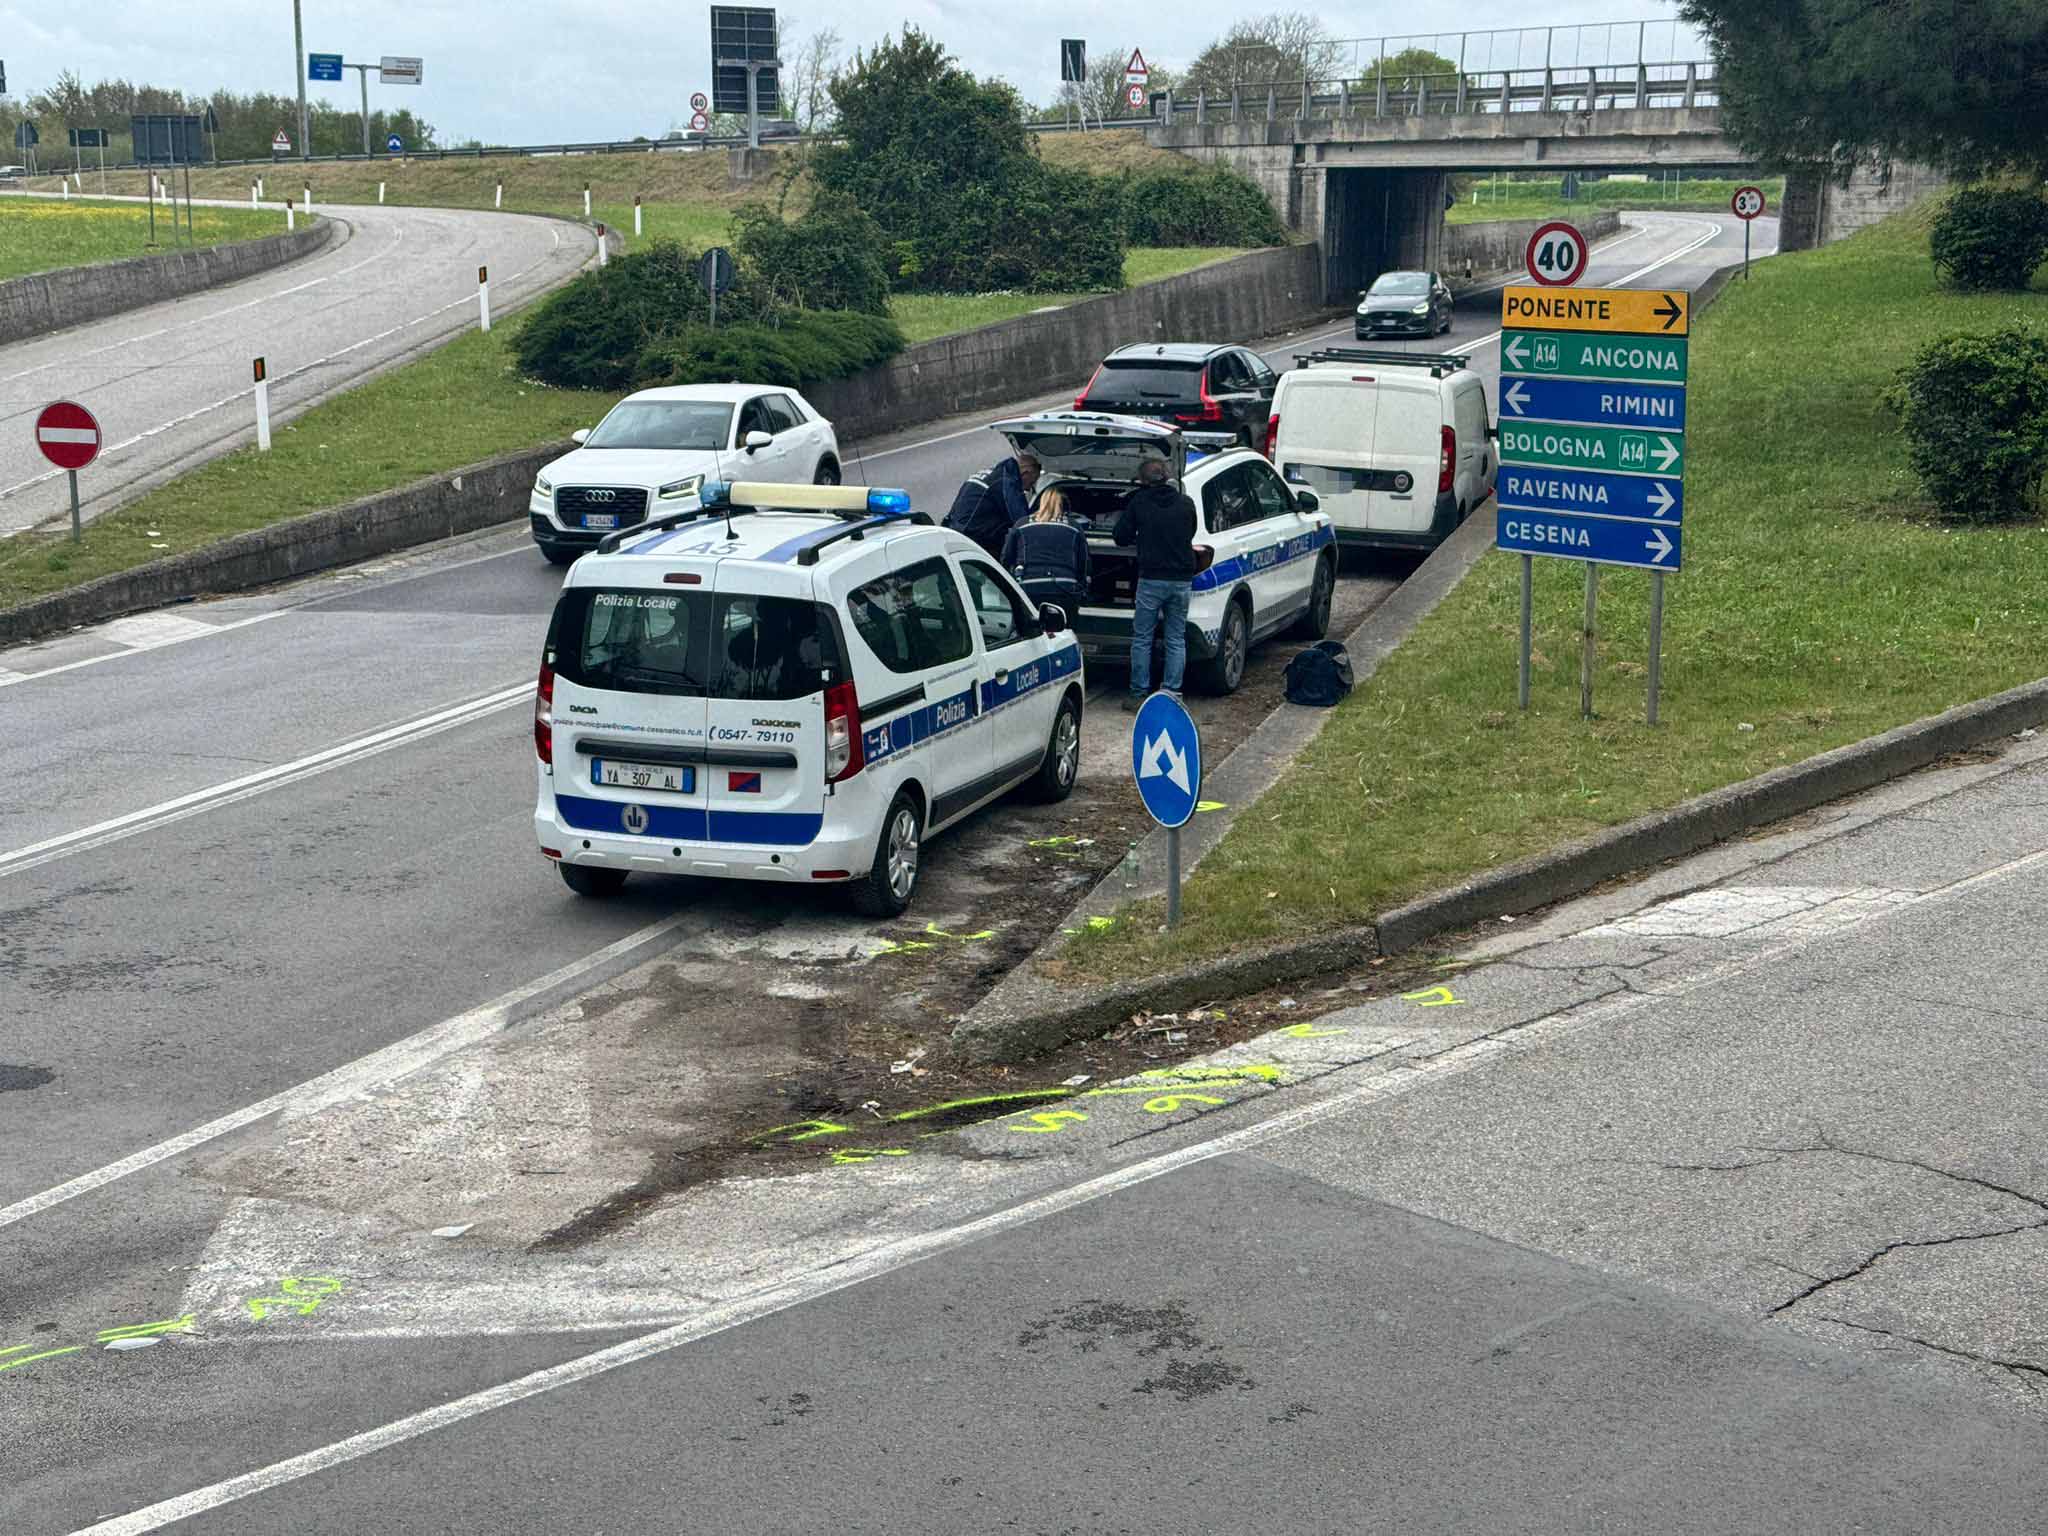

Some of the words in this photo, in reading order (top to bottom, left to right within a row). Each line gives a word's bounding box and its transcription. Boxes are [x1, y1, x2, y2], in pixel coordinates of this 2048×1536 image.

[1538, 241, 1574, 271] 40
[1507, 297, 1610, 320] PONENTE
[1535, 342, 1557, 364] A14
[1580, 346, 1679, 371] ANCONA
[1600, 395, 1675, 417] RIMINI
[1503, 432, 1606, 459] BOLOGNA
[1621, 442, 1644, 464] A14
[1507, 477, 1608, 504] RAVENNA
[1506, 521, 1591, 547] CESENA
[595, 594, 634, 607] Polizia
[637, 597, 677, 610] Locale
[936, 697, 966, 728] Polizia
[1016, 664, 1040, 692] Locale
[751, 718, 801, 728] DOKKER
[756, 731, 794, 743] 79110
[607, 768, 619, 783] YA
[632, 772, 651, 786] 307
[664, 775, 678, 789] AL
